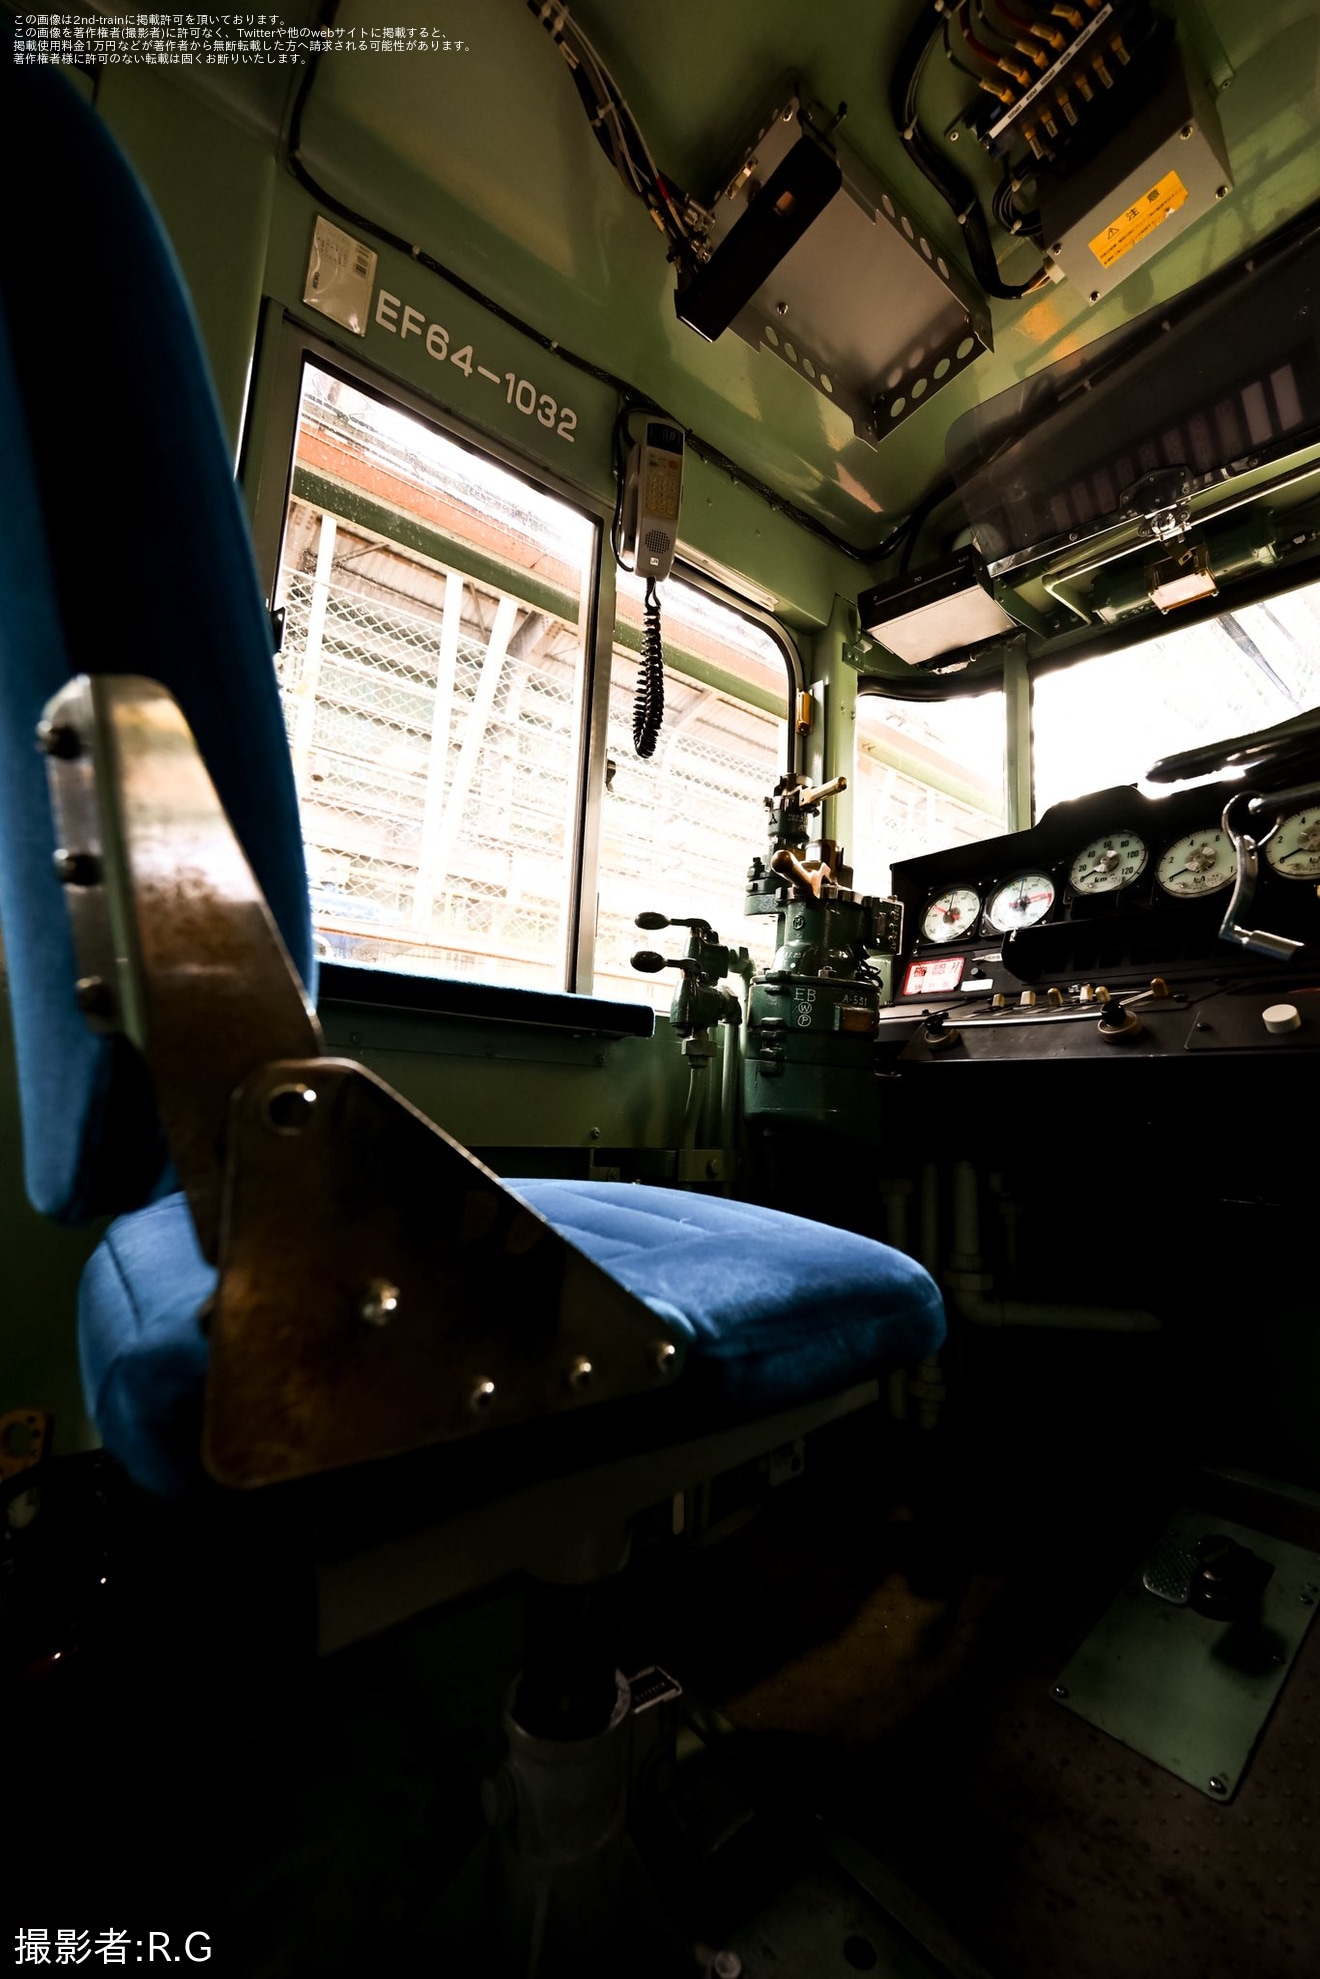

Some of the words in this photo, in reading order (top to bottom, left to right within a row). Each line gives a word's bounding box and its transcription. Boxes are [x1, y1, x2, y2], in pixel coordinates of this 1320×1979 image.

[375, 289, 578, 443] EF64-1032
[1127, 850, 1139, 858] 100
[1079, 864, 1087, 872] 20
[1121, 867, 1134, 875] 120
[793, 988, 816, 1002] EB
